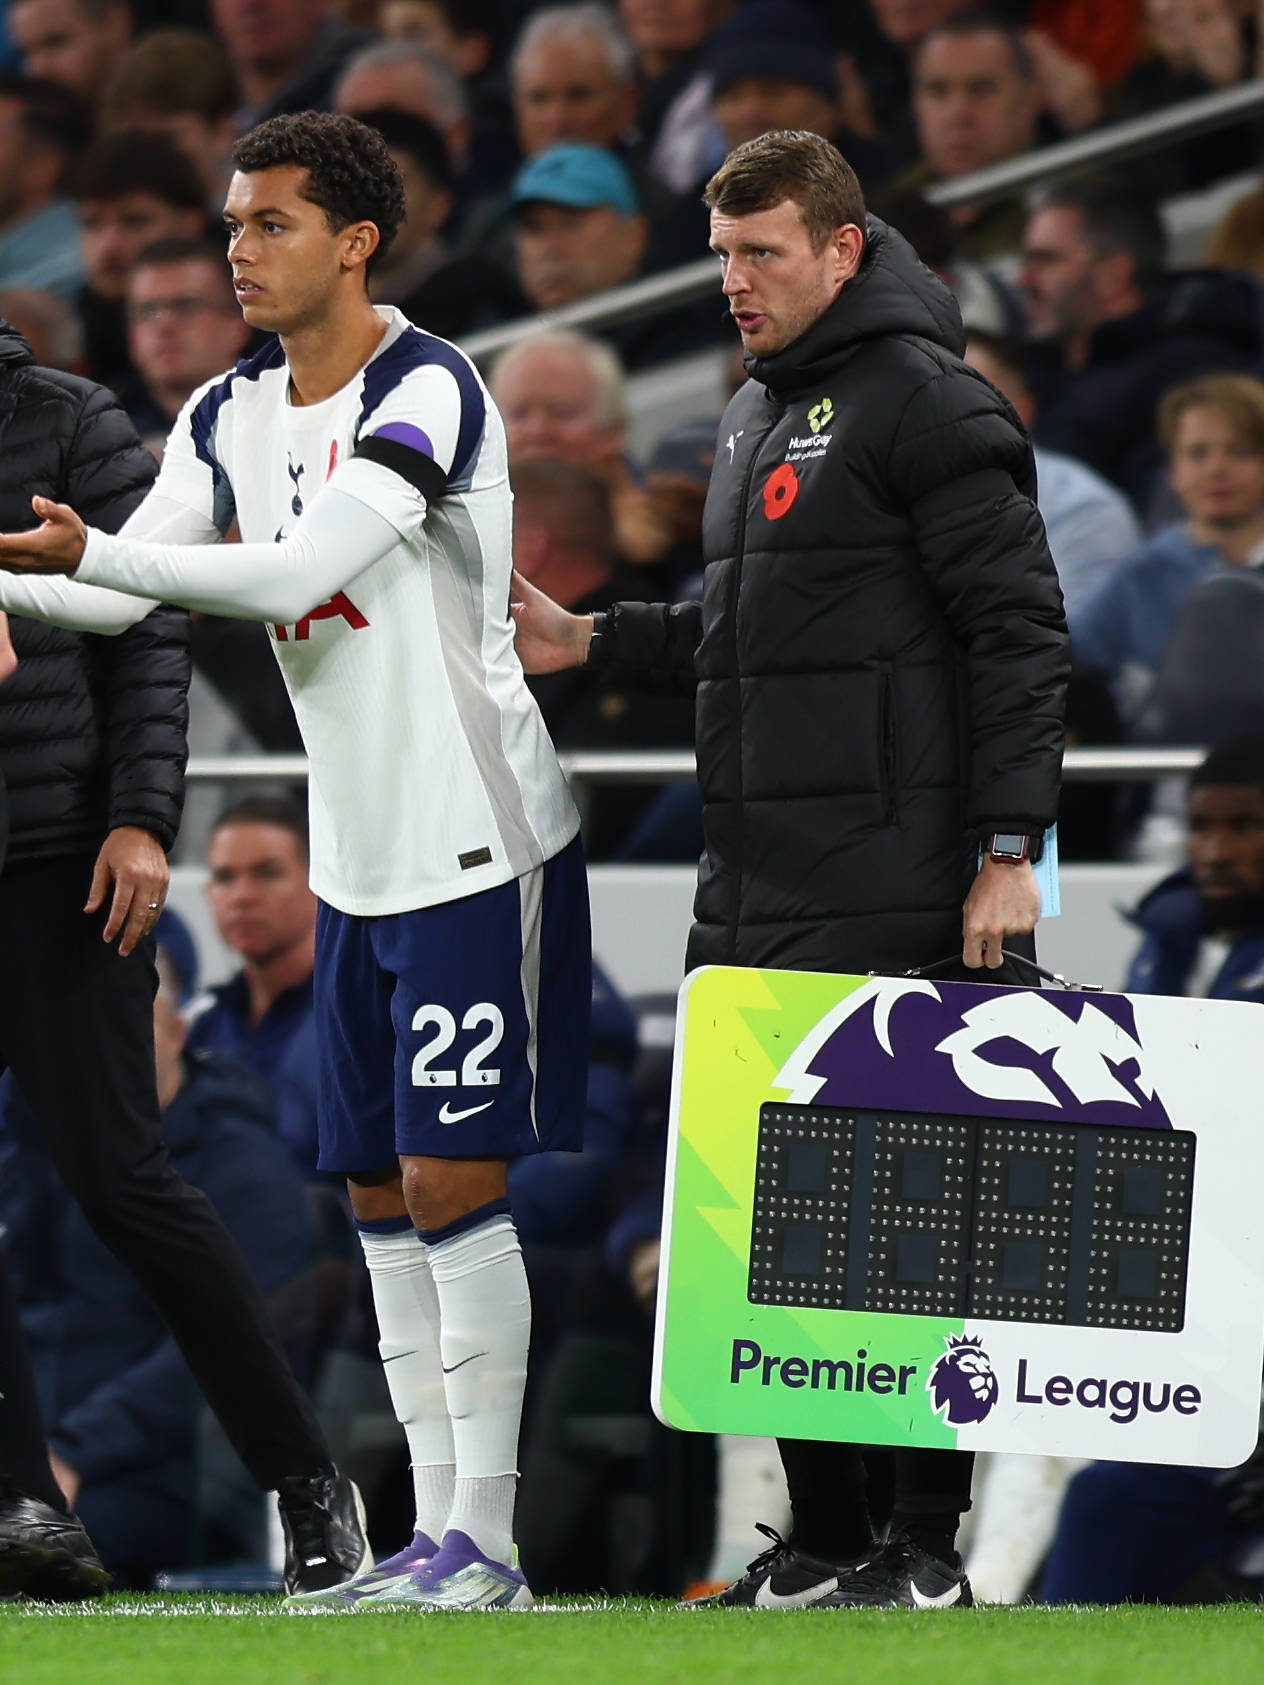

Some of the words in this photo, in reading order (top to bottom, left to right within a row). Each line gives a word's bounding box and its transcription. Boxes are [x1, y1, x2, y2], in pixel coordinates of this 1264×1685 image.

[411, 1002, 505, 1087] 22
[730, 1339, 917, 1396] Premier
[1016, 1359, 1202, 1424] League
